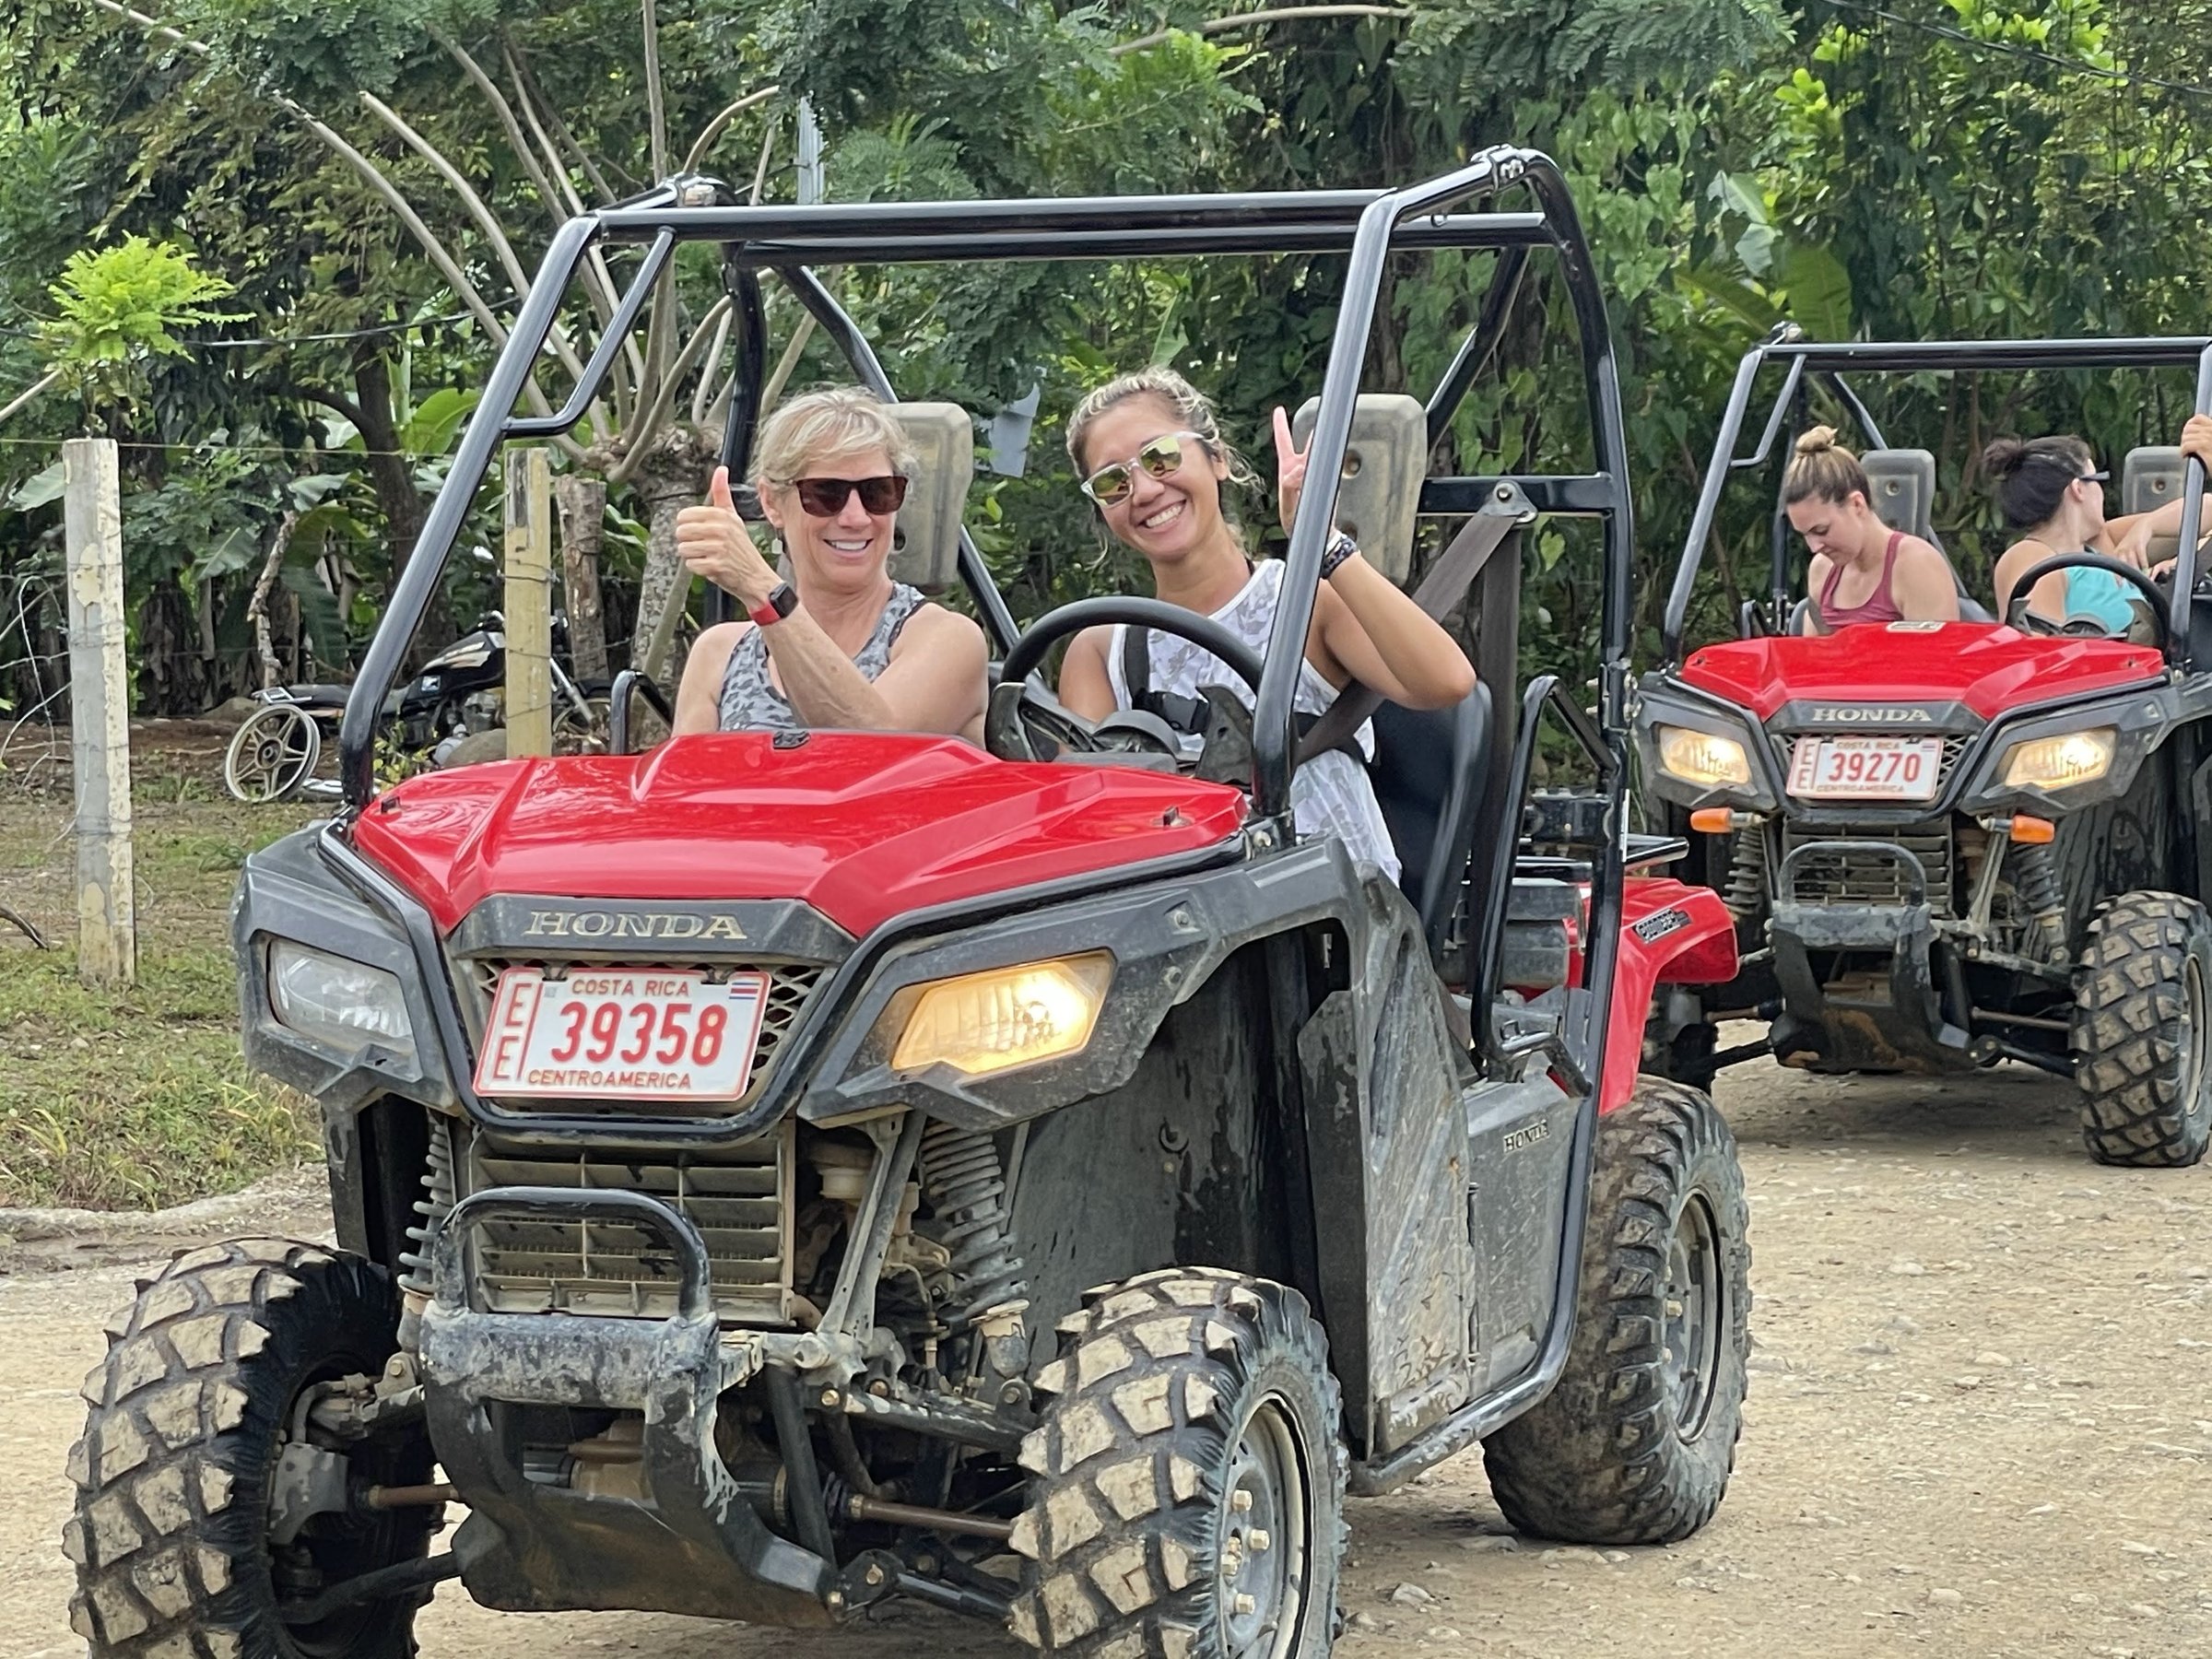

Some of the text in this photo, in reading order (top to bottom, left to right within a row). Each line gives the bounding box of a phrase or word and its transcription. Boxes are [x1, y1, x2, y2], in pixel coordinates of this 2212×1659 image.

[1813, 708, 1932, 722] HONDA
[1829, 753, 1922, 782] 39270
[1817, 784, 1905, 793] CENTROAMERICA
[524, 911, 747, 939] HONDA
[571, 980, 689, 997] COSTA RICA
[551, 1001, 728, 1066] 39358
[528, 1069, 691, 1088] CENTROAMERICA
